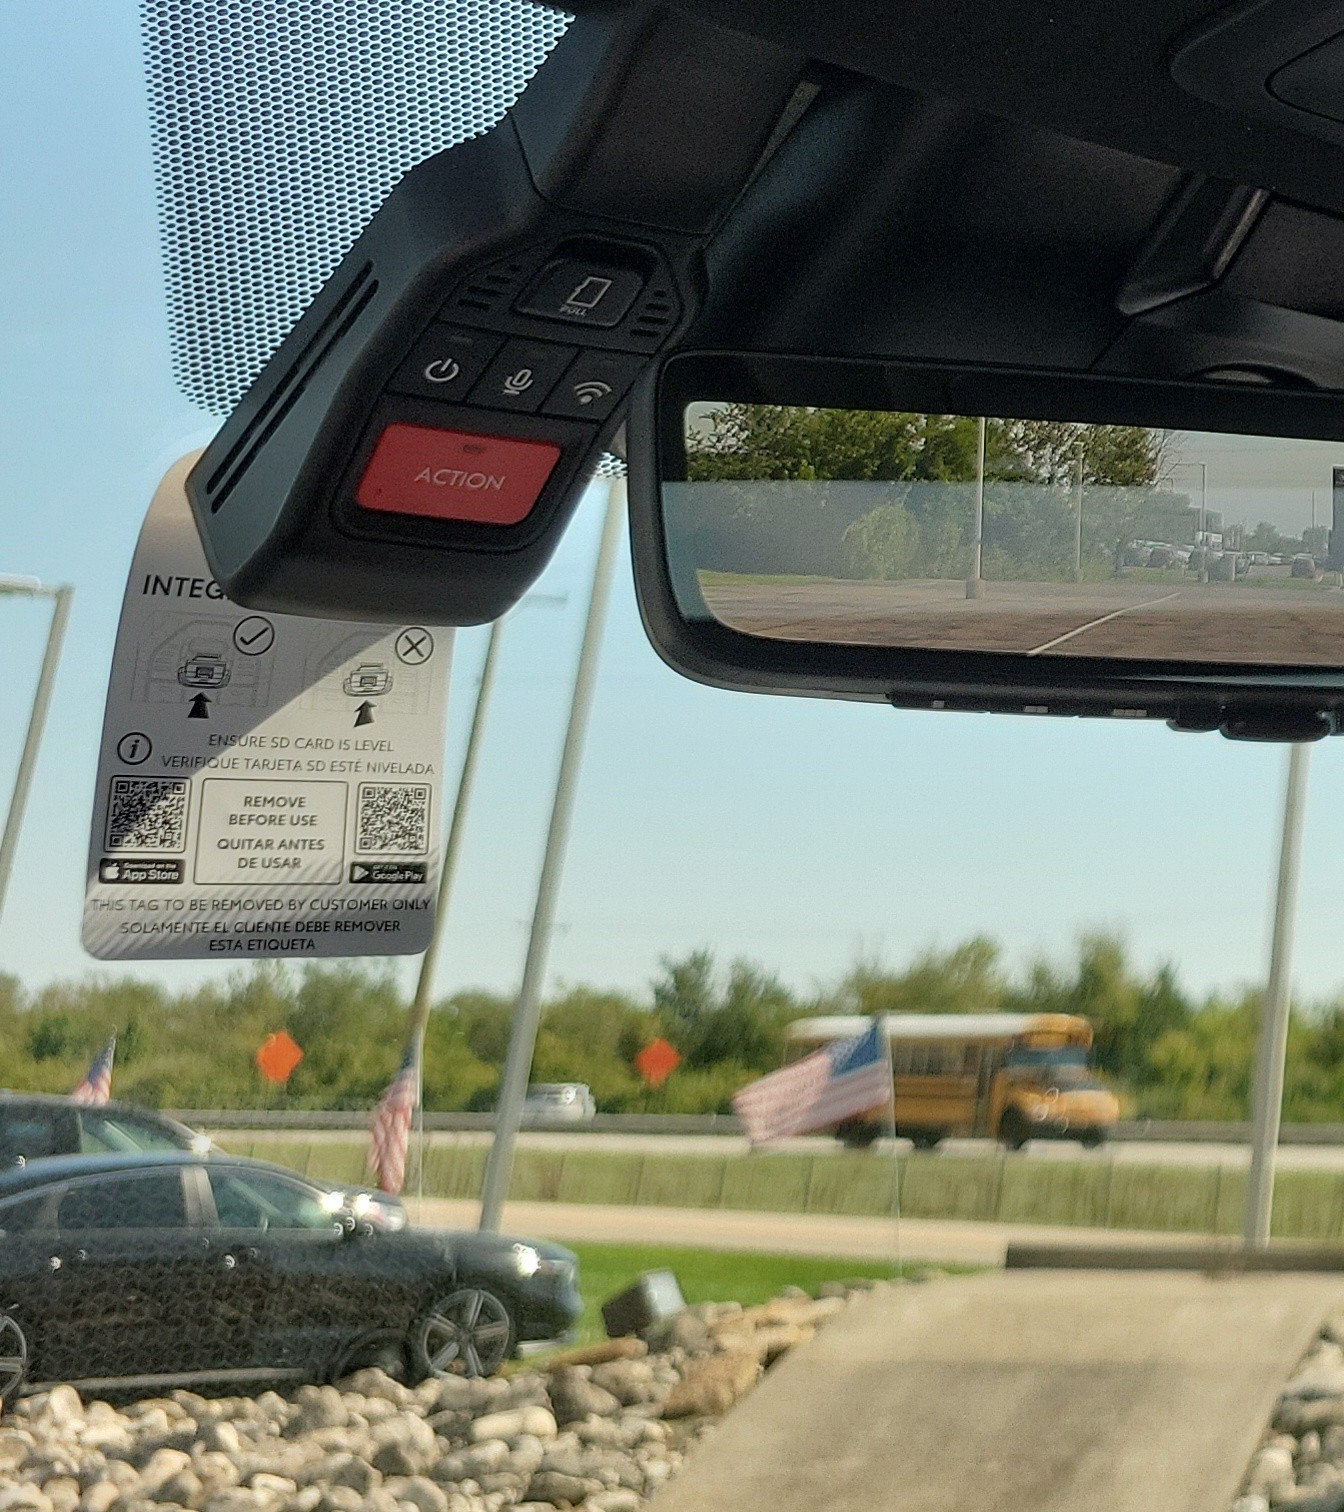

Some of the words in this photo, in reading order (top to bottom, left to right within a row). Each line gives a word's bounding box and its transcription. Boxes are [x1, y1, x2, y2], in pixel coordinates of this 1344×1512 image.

[414, 469, 507, 491] ACTION
[142, 574, 230, 600] INTEG
[208, 734, 266, 748] ENSURE
[270, 736, 290, 749] SD
[295, 737, 334, 750] CARD
[338, 739, 351, 751] IS
[355, 739, 394, 752] LEVEL
[161, 755, 239, 770] VERIFIQUE
[244, 757, 302, 772] TARJETA
[307, 759, 326, 772] SD
[366, 761, 435, 775] NIVELADA
[244, 796, 306, 808] REMOVE
[229, 814, 286, 826] BEFORE
[291, 815, 319, 827] USE
[217, 838, 274, 851] QUITAR
[278, 839, 325, 851] ANTES
[238, 857, 258, 869] DE
[262, 857, 302, 869] USAR
[122, 869, 147, 881] App
[148, 869, 179, 880] Store
[372, 870, 404, 882] Google
[405, 870, 424, 882] Play
[91, 899, 125, 911] THIS
[129, 899, 159, 911] TAG
[165, 899, 185, 911] TO
[189, 899, 207, 911] BE
[212, 899, 284, 911] REMOVED
[288, 899, 307, 911] BY
[310, 898, 388, 911] CUSTOMER
[393, 898, 431, 911] ONLY
[121, 921, 211, 934] SOLAMENTE
[214, 921, 229, 934] EL
[234, 921, 291, 934] CLIENTE
[296, 920, 330, 933] DEBE
[335, 920, 401, 933] REMOVER
[209, 940, 243, 952] ESTA
[248, 938, 316, 952] ETIQUETA
